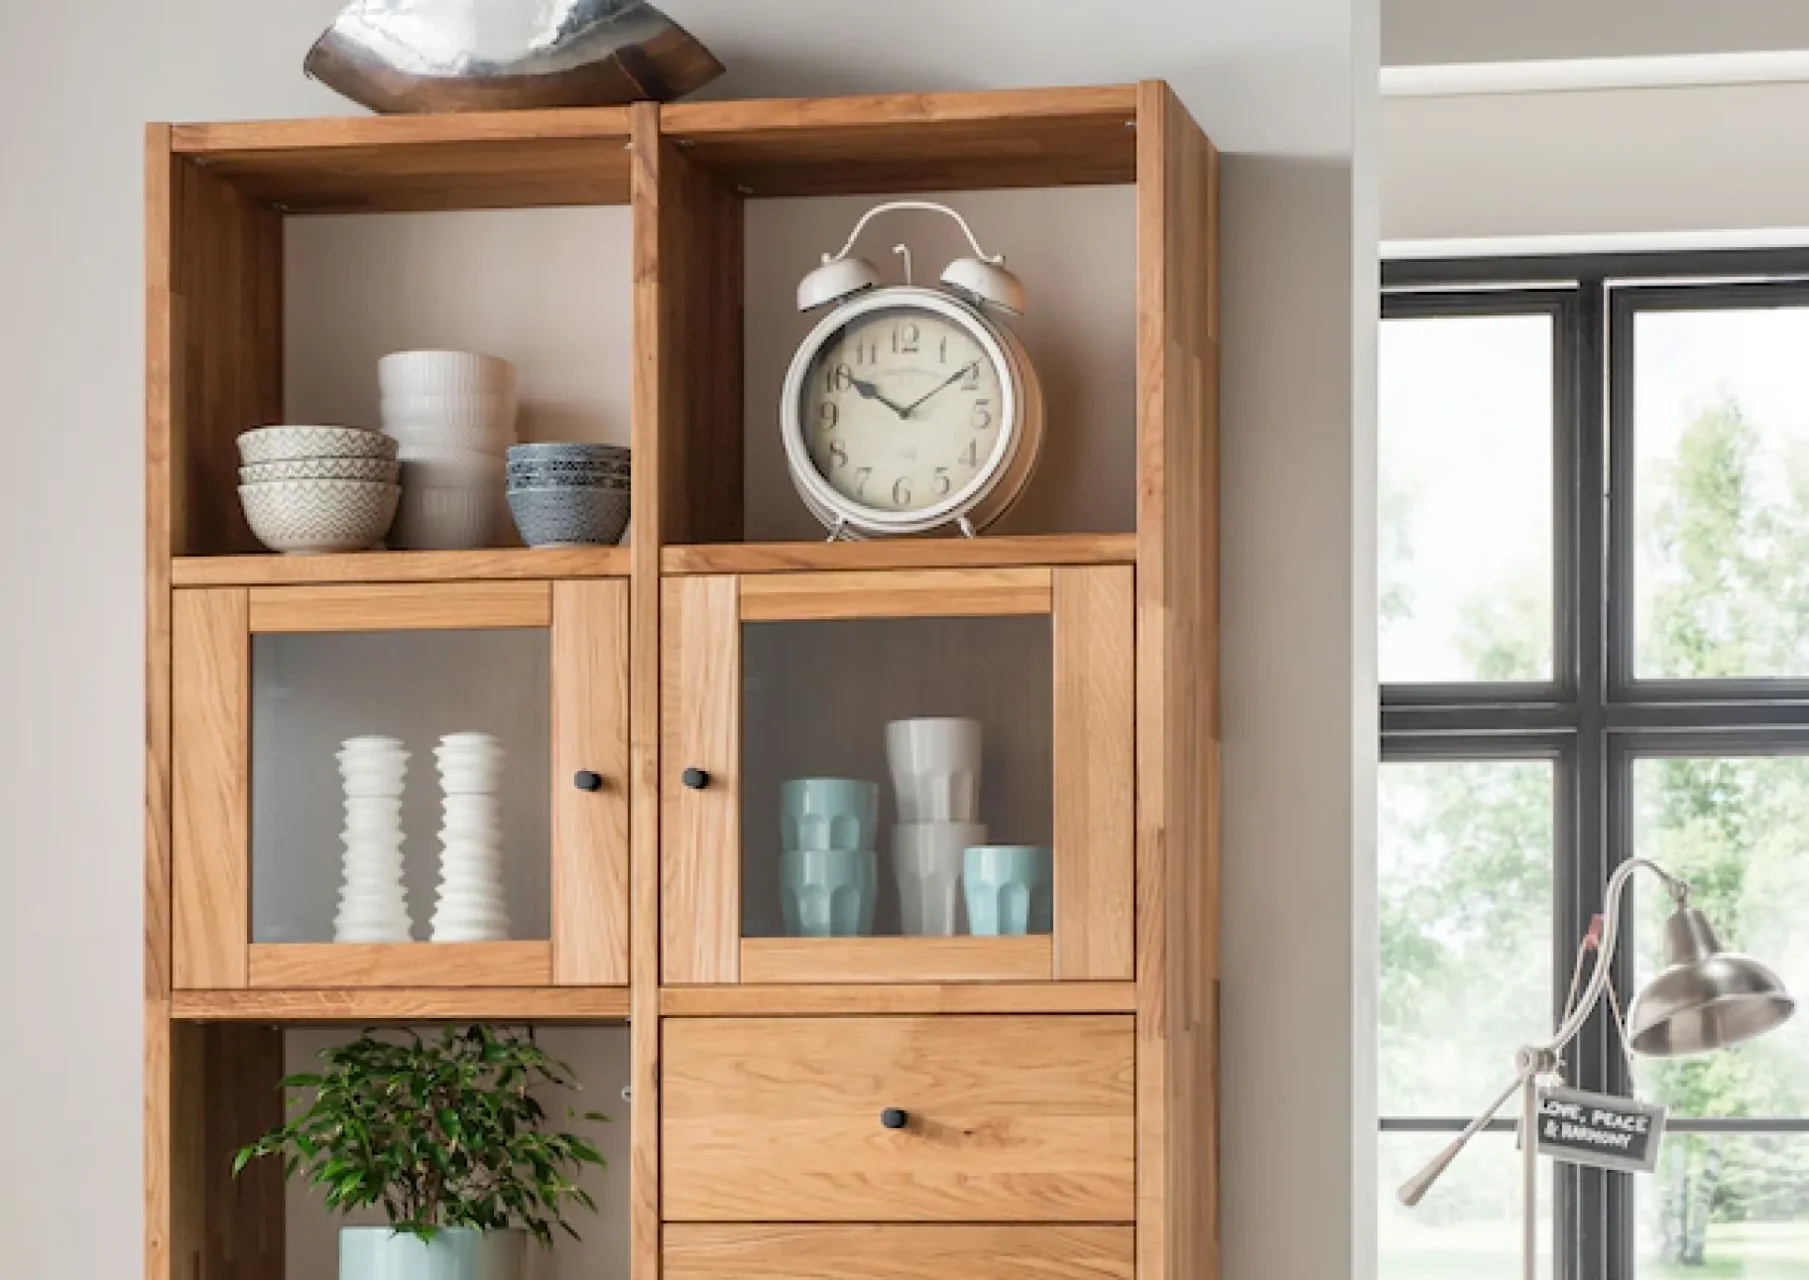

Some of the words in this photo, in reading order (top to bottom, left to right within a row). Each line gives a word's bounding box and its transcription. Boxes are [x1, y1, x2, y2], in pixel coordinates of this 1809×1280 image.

[856, 339, 877, 366] 11
[891, 323, 920, 355] 12
[939, 335, 947, 364] 1
[826, 364, 852, 394] 10
[961, 360, 980, 392] 2
[820, 400, 838, 431] 9
[830, 439, 849, 468] 8
[958, 437, 977, 468] 4
[855, 466, 873, 498] 7
[892, 475, 912, 507] 6
[930, 466, 951, 497] 5
